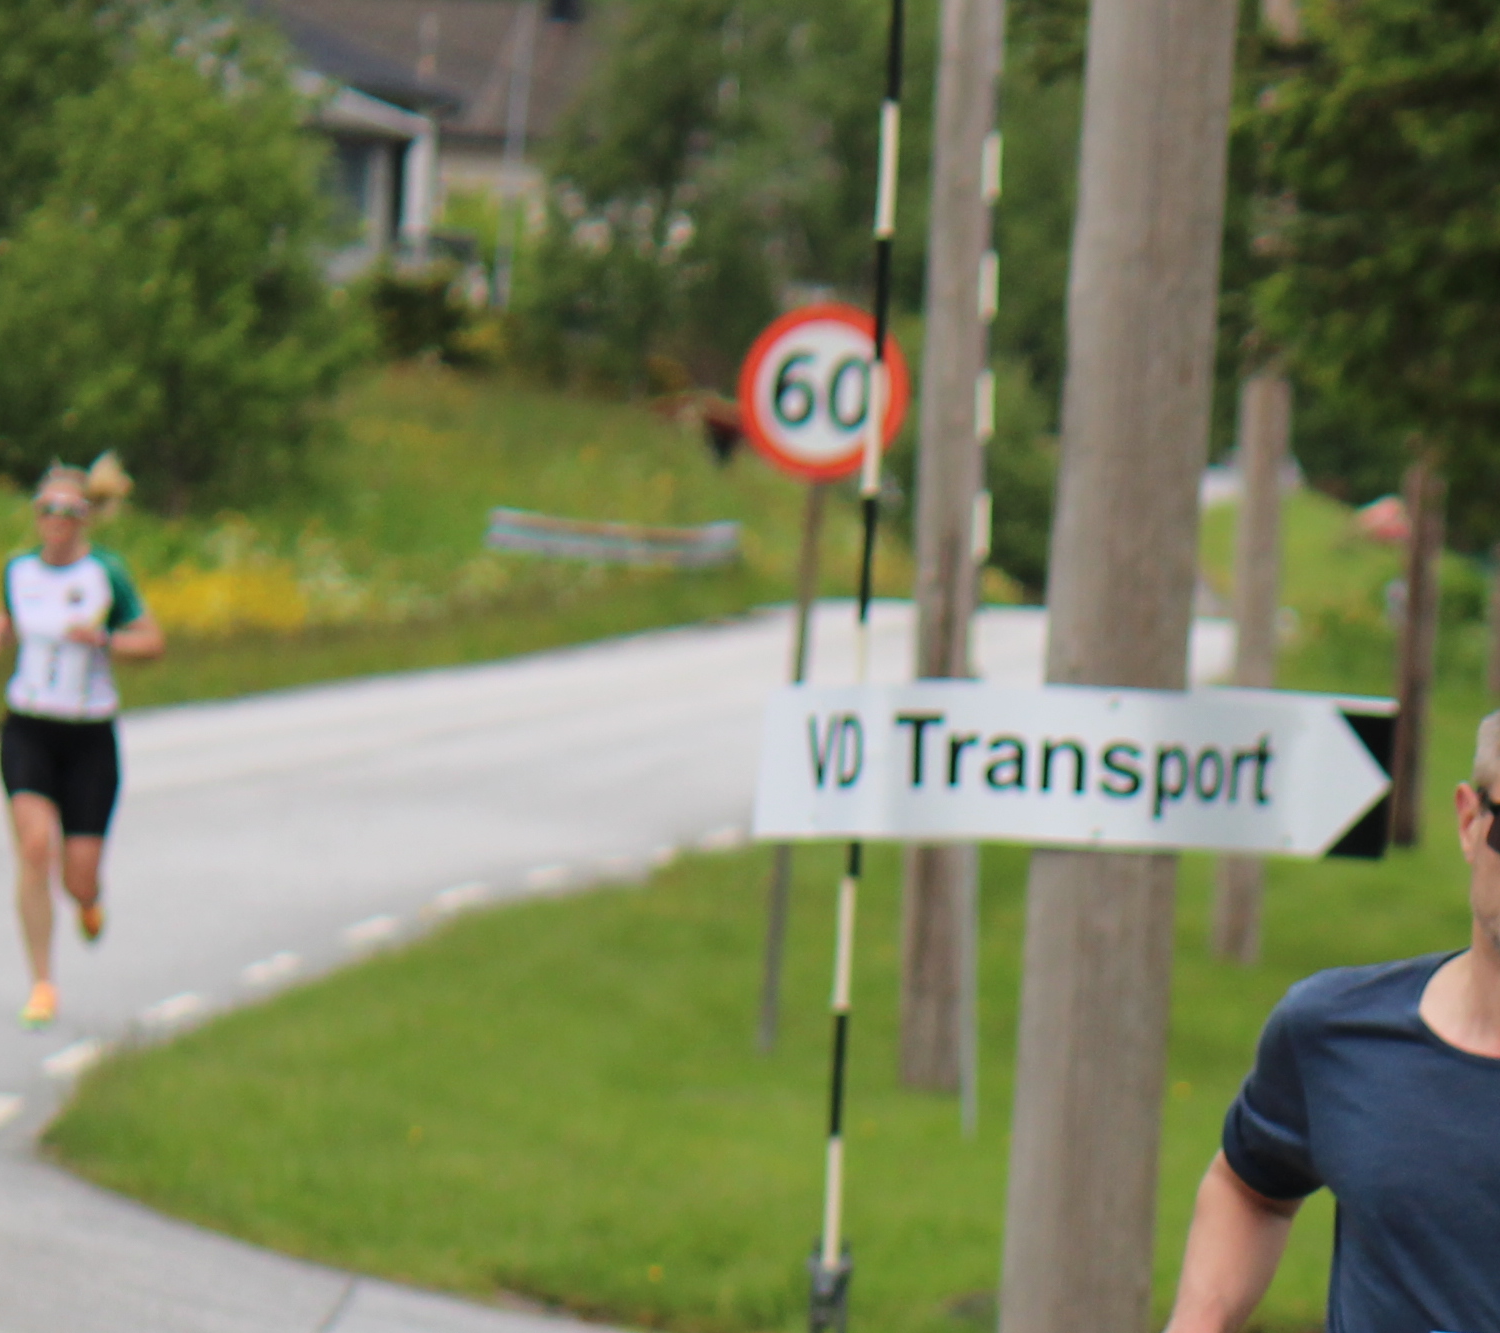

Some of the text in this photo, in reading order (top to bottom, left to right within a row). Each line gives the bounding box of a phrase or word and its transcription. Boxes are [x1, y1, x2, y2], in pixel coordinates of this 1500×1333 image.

[773, 351, 872, 433] 60
[809, 713, 1273, 820] VD Transport
